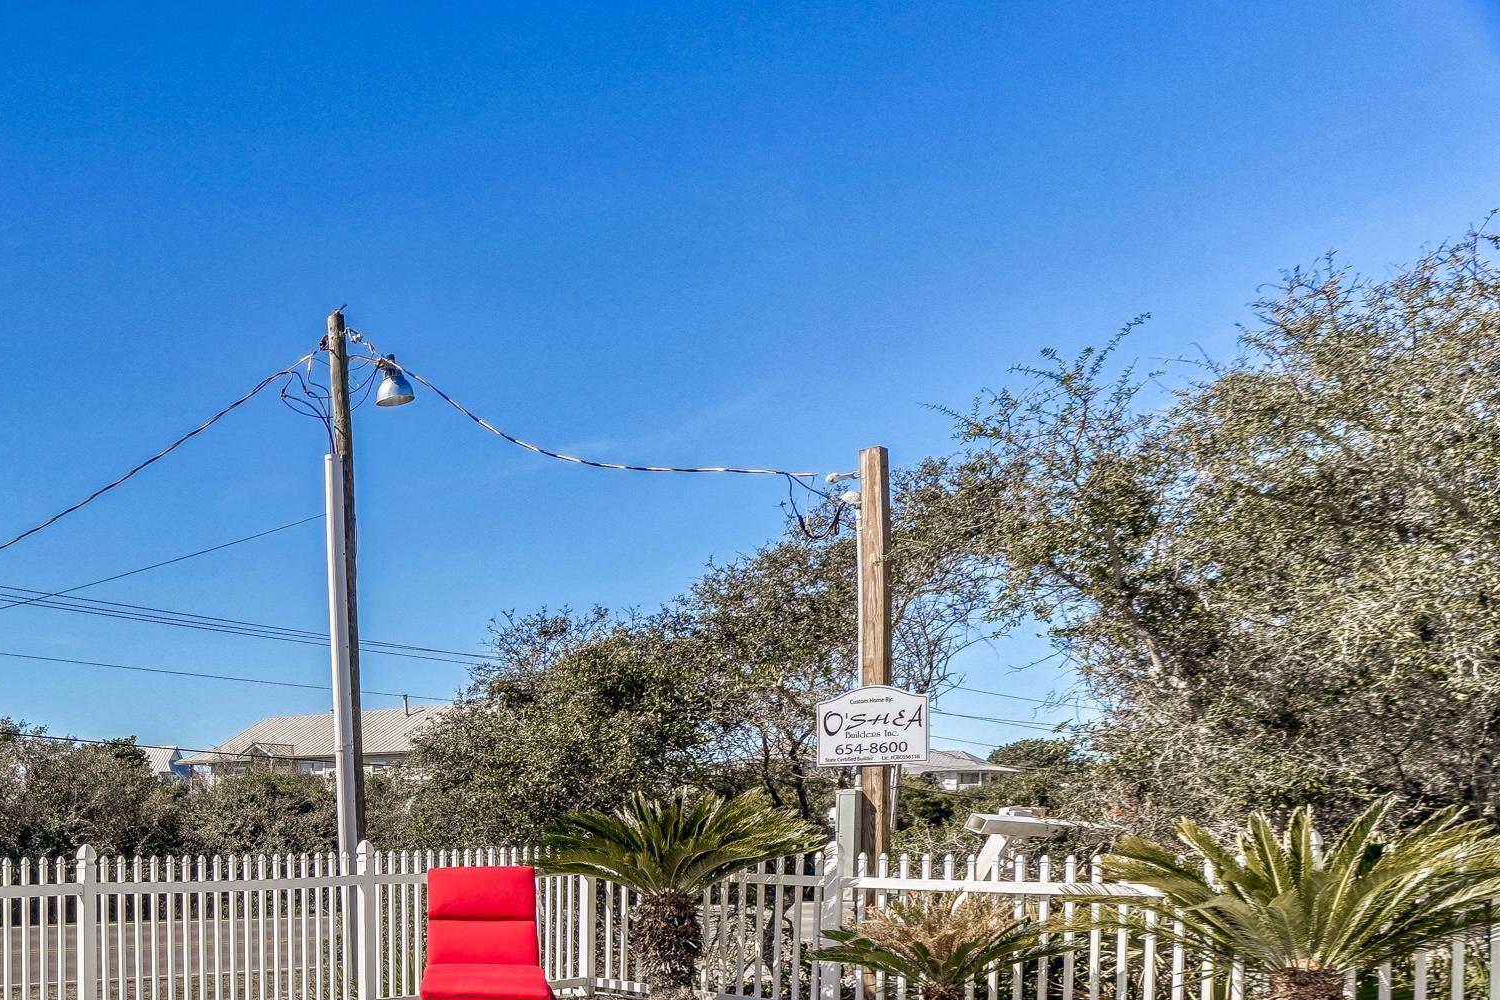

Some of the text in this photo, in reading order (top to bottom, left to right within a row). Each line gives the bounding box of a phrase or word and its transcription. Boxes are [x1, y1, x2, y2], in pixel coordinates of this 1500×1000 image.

[823, 704, 923, 737] O'SHEA
[845, 729, 899, 739] Builders Inc.
[835, 741, 908, 755] 654-8600
